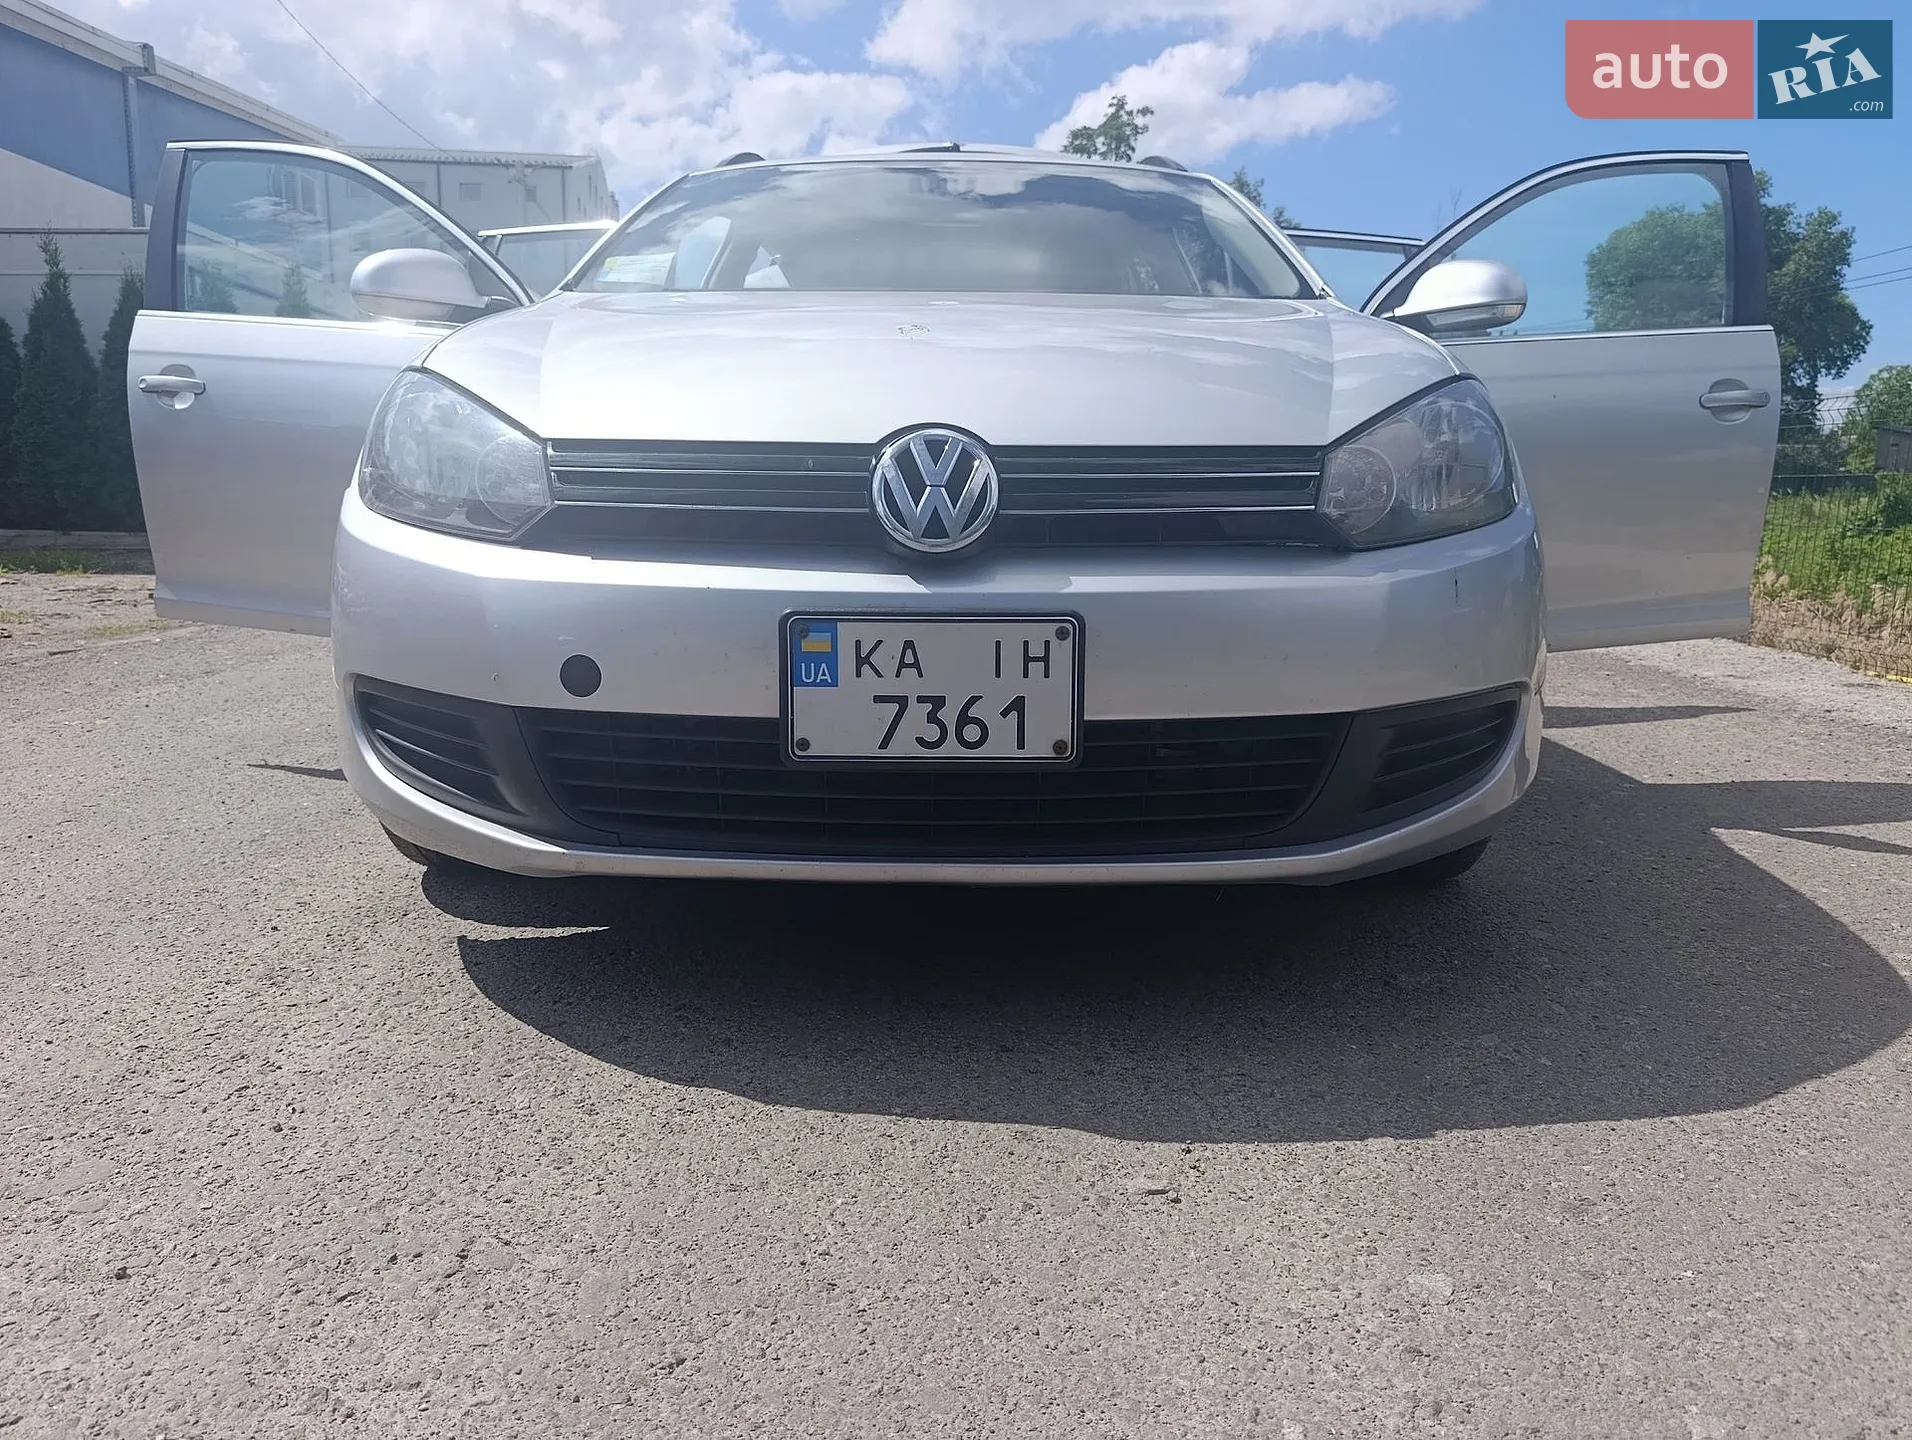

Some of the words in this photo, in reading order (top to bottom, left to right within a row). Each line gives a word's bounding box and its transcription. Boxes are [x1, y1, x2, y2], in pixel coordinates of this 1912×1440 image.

[801, 662, 832, 684] UA
[854, 639, 924, 679] KA
[994, 639, 1051, 679] IH
[872, 694, 1027, 750] 7361
